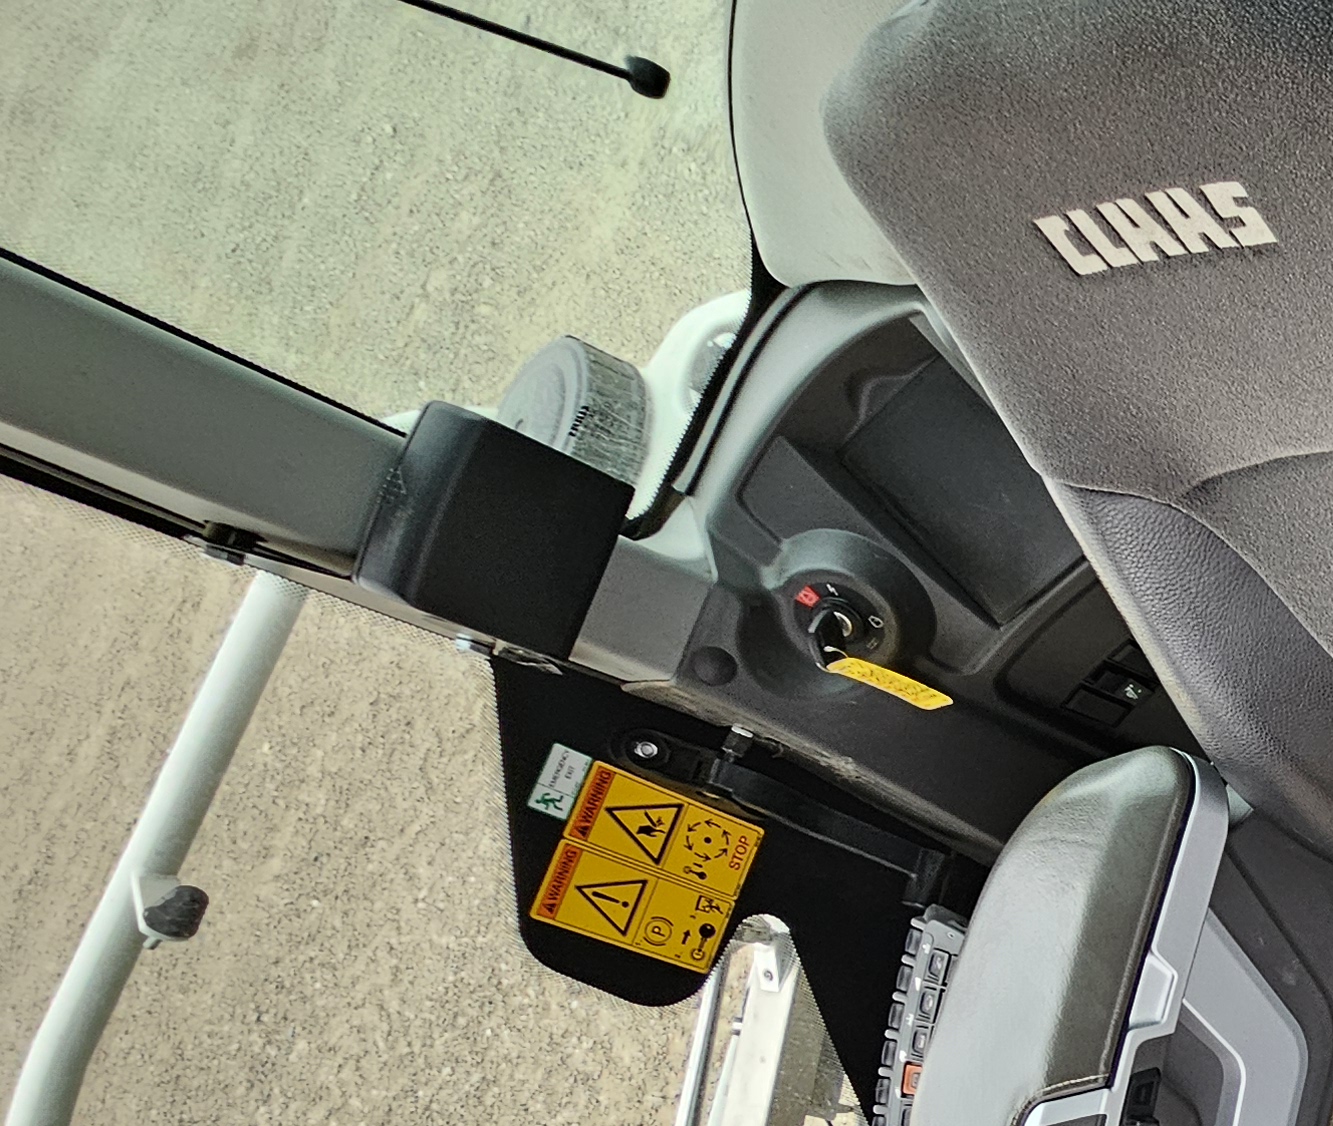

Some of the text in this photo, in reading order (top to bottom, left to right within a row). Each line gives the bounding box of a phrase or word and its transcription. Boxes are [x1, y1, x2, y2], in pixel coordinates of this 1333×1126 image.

[1032, 181, 1278, 276] CLAAS
[547, 749, 570, 787] EMERGENCY
[579, 769, 612, 824] WARNING
[547, 848, 577, 901] WARNING
[727, 834, 752, 871] STOP
